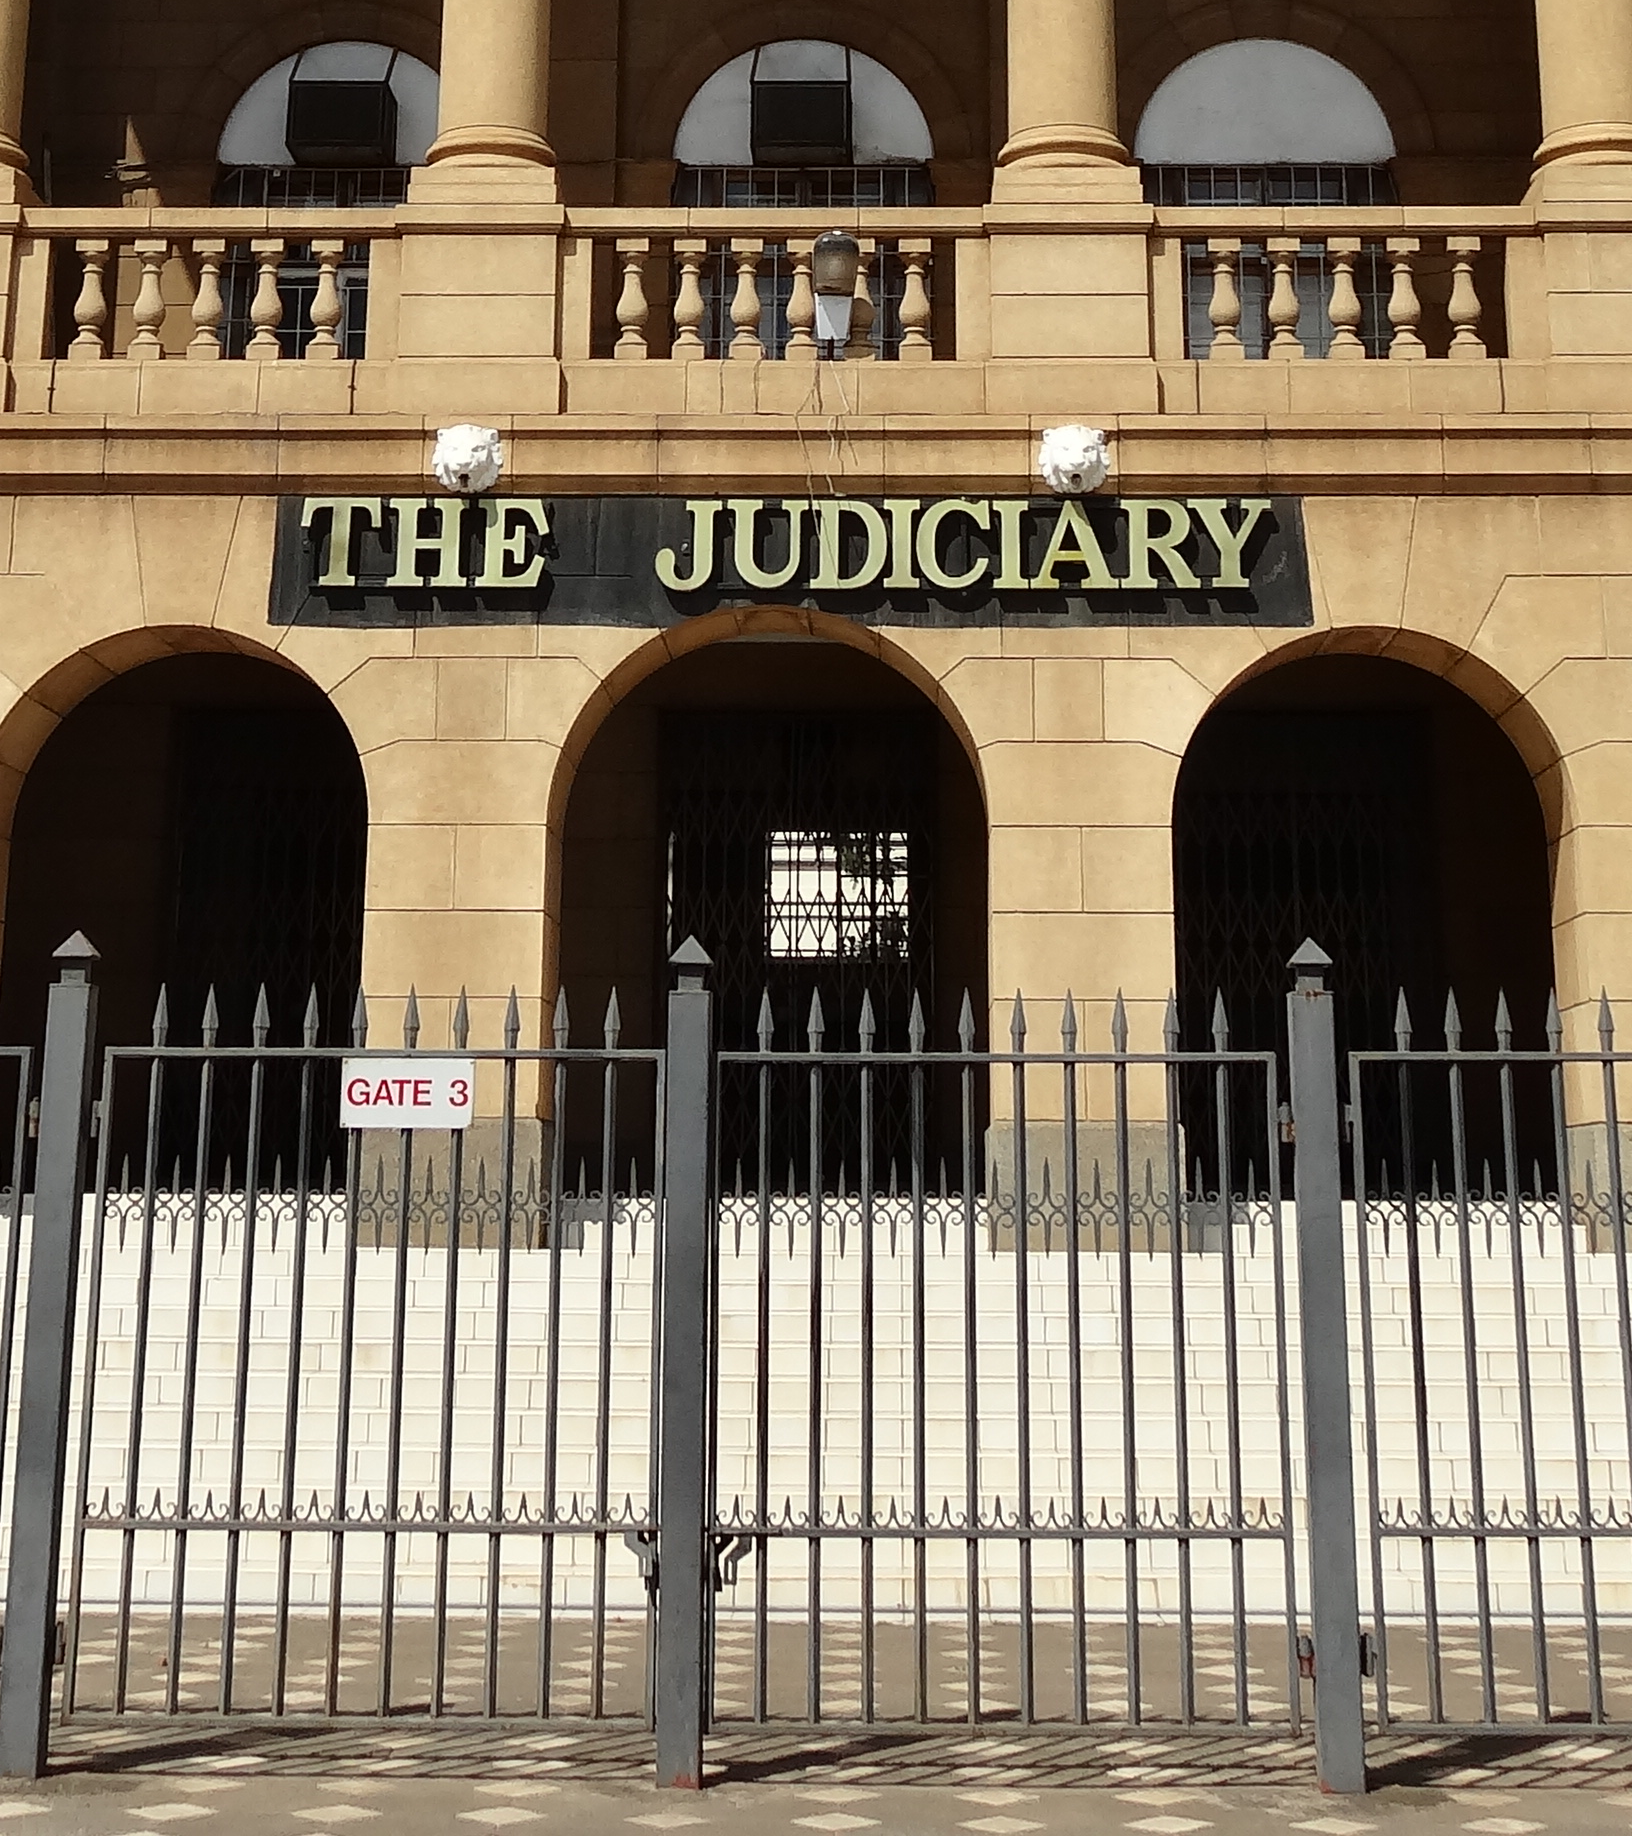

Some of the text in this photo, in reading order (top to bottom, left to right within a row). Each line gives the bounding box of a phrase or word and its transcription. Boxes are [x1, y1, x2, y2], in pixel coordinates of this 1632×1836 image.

[300, 497, 1272, 591] THE JUDICIARY
[347, 1078, 469, 1107] GATE 3
